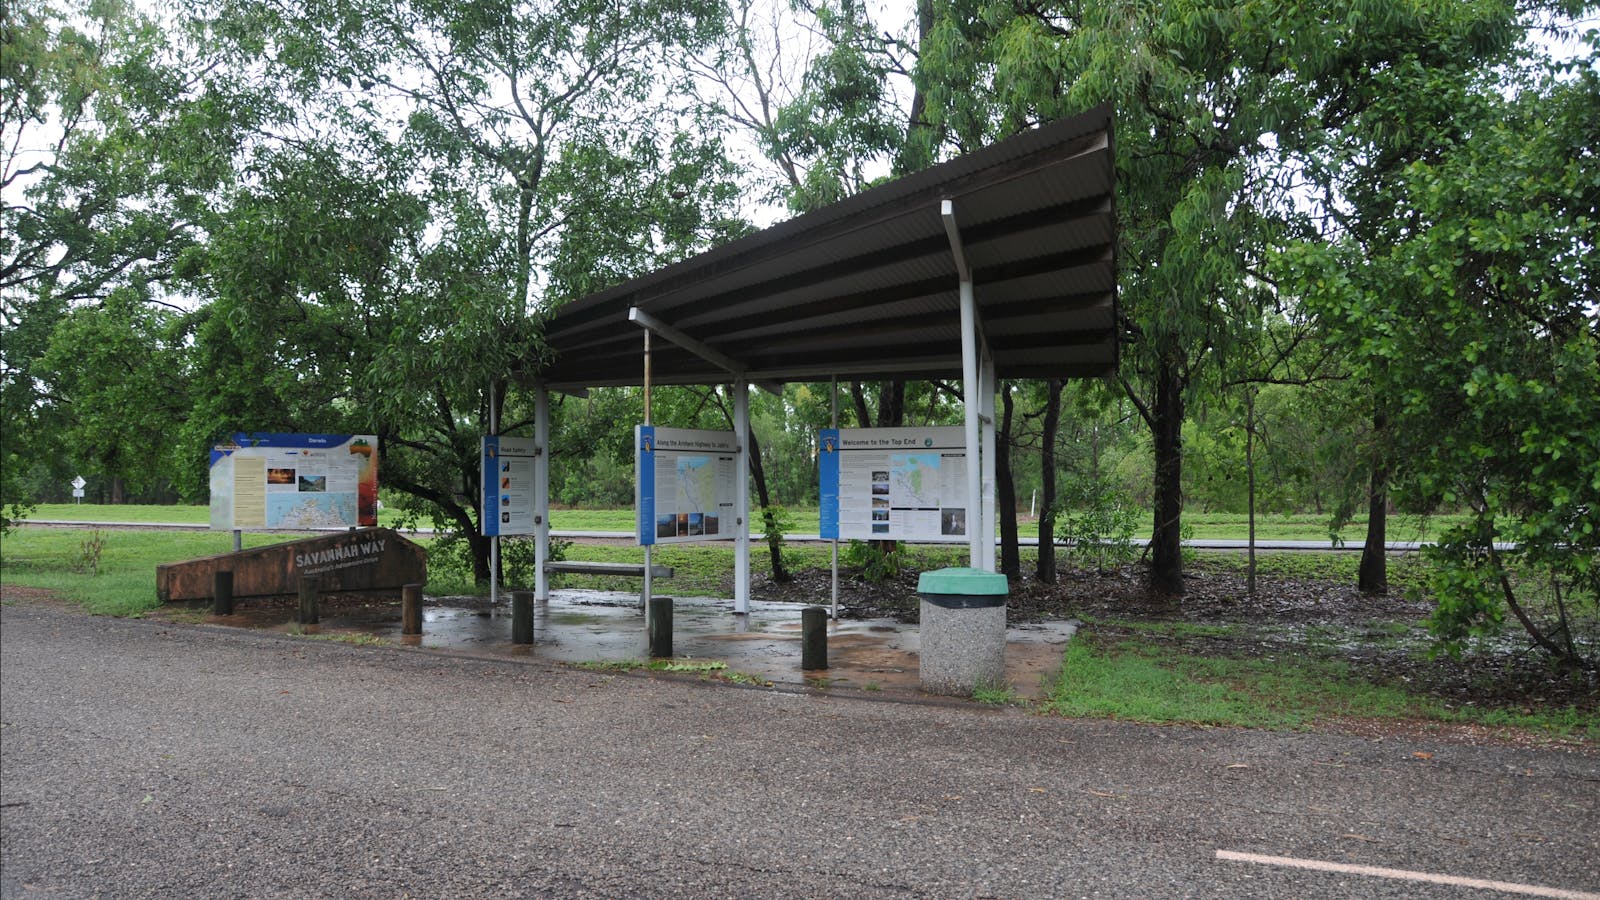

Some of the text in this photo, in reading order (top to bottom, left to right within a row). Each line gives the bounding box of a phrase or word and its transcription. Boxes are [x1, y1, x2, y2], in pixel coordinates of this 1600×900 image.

[657, 439, 669, 447] Along
[891, 438, 902, 447] Top
[296, 539, 386, 568] SAVANNAH WAY
